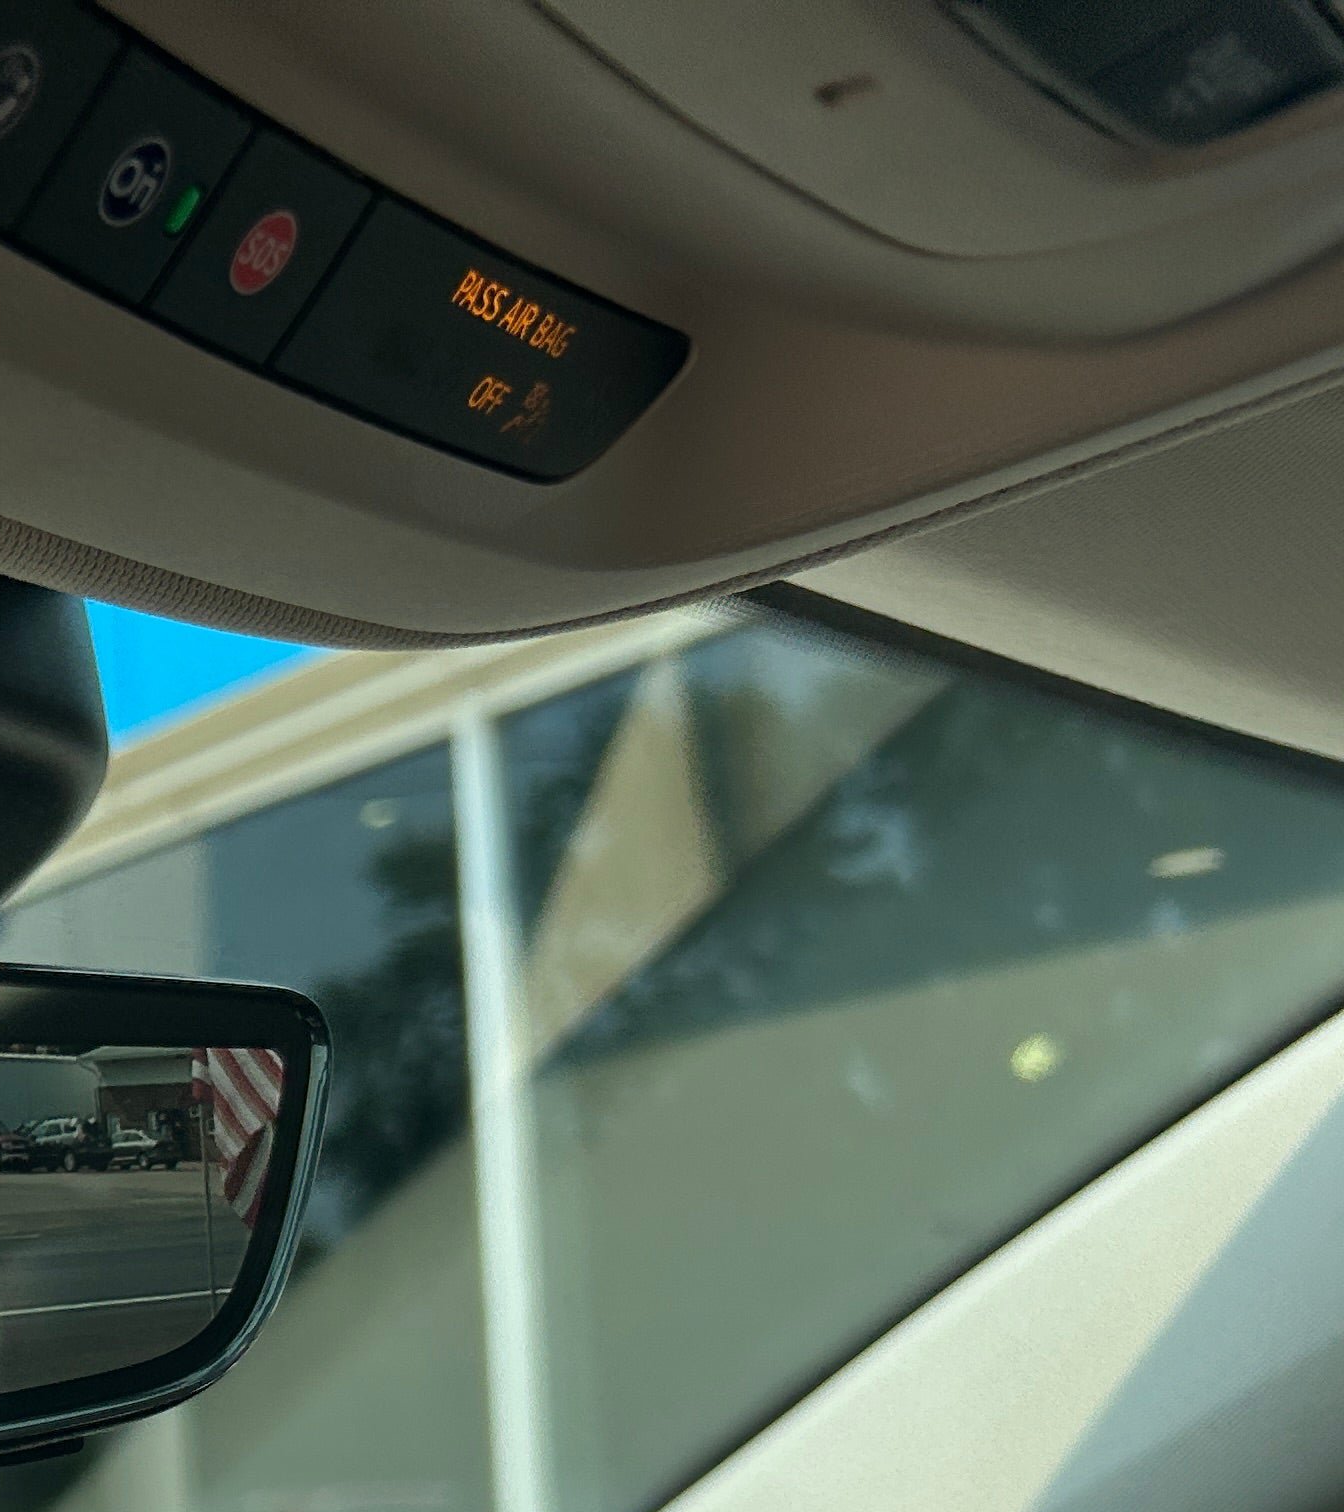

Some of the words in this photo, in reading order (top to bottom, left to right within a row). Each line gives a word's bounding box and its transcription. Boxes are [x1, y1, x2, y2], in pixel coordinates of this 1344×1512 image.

[237, 232, 288, 276] SOS
[451, 268, 511, 321] PASS
[496, 297, 539, 340] AIR
[528, 312, 577, 358] BAG
[468, 375, 512, 415] OFF
